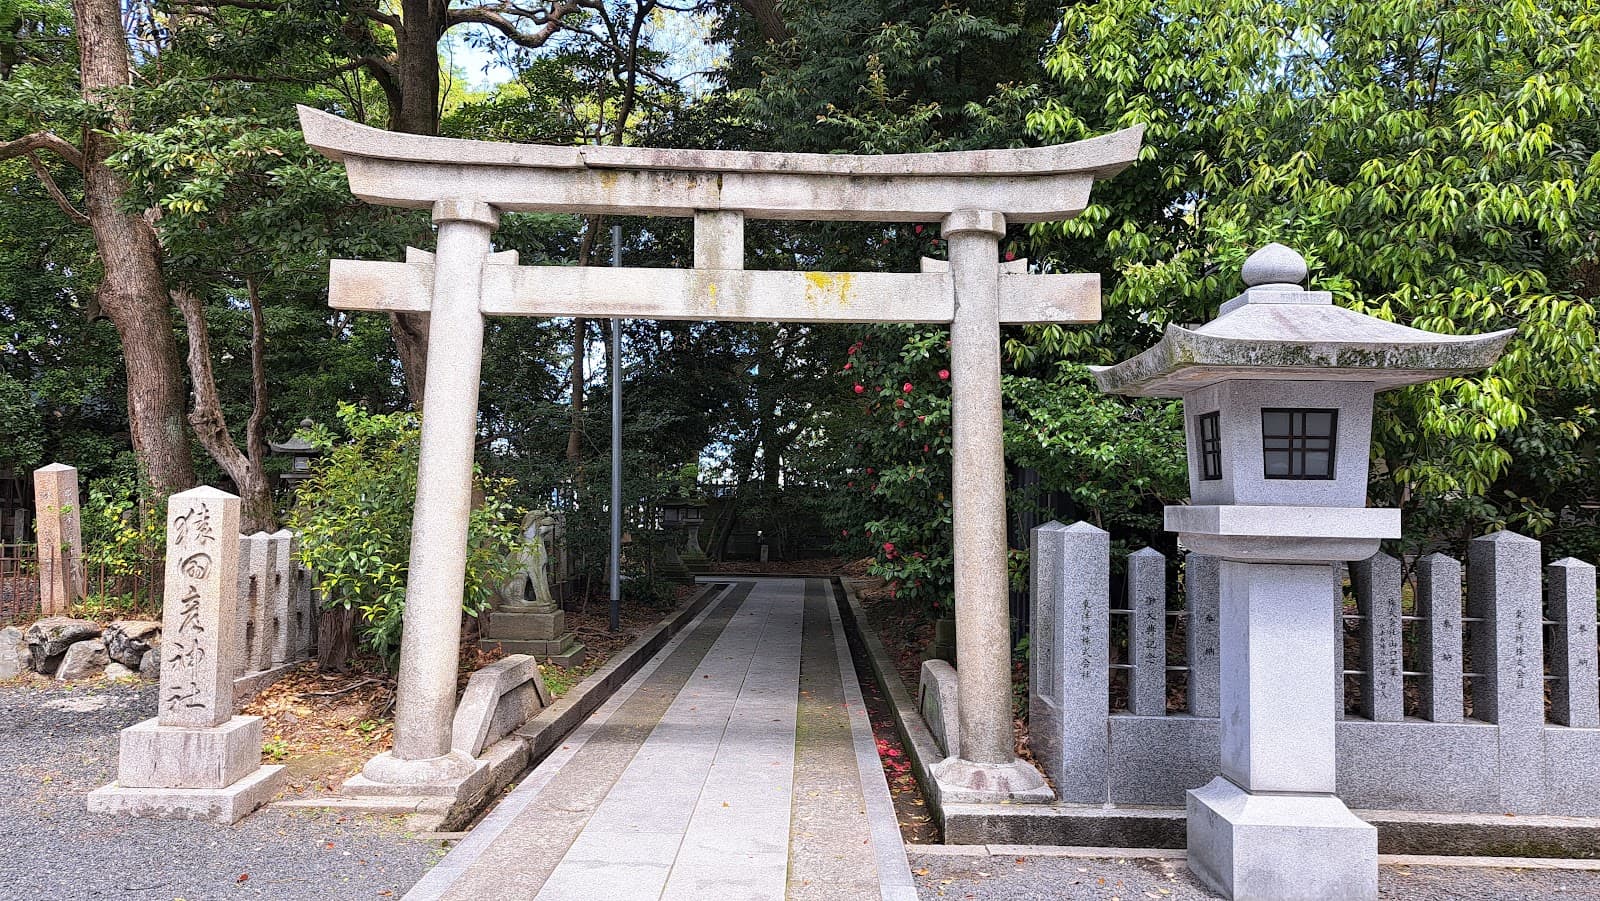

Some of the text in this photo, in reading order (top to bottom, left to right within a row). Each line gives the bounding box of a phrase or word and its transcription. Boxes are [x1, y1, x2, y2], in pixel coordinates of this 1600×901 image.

[166, 502, 215, 711] 猿田彦神社
[1144, 596, 1158, 664] 御大典記念
